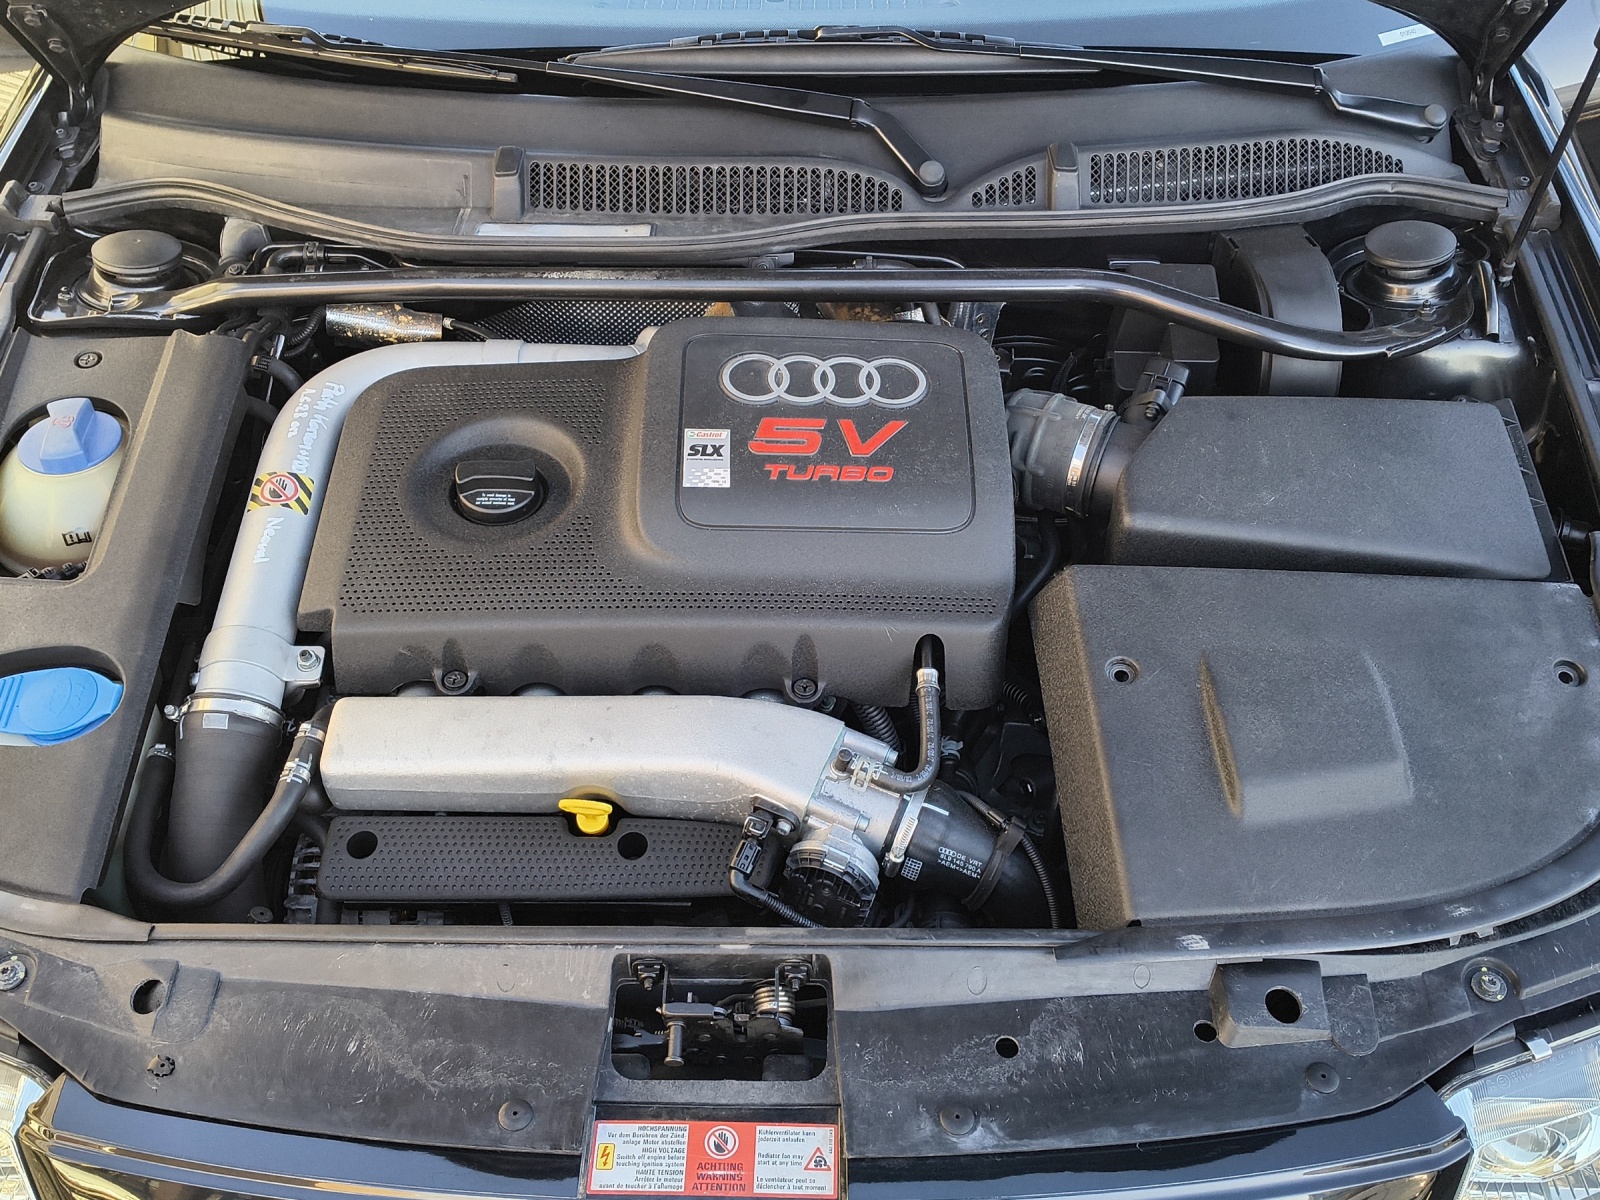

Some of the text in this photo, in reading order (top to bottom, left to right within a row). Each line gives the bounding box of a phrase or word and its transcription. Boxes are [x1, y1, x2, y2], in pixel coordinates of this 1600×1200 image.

[748, 417, 909, 457] 5V
[687, 444, 725, 457] SLX
[764, 463, 895, 482] TURBO
[696, 1161, 744, 1171] ACHTUNG
[696, 1172, 743, 1181] WARNING
[691, 1182, 746, 1192] ATTENTION
